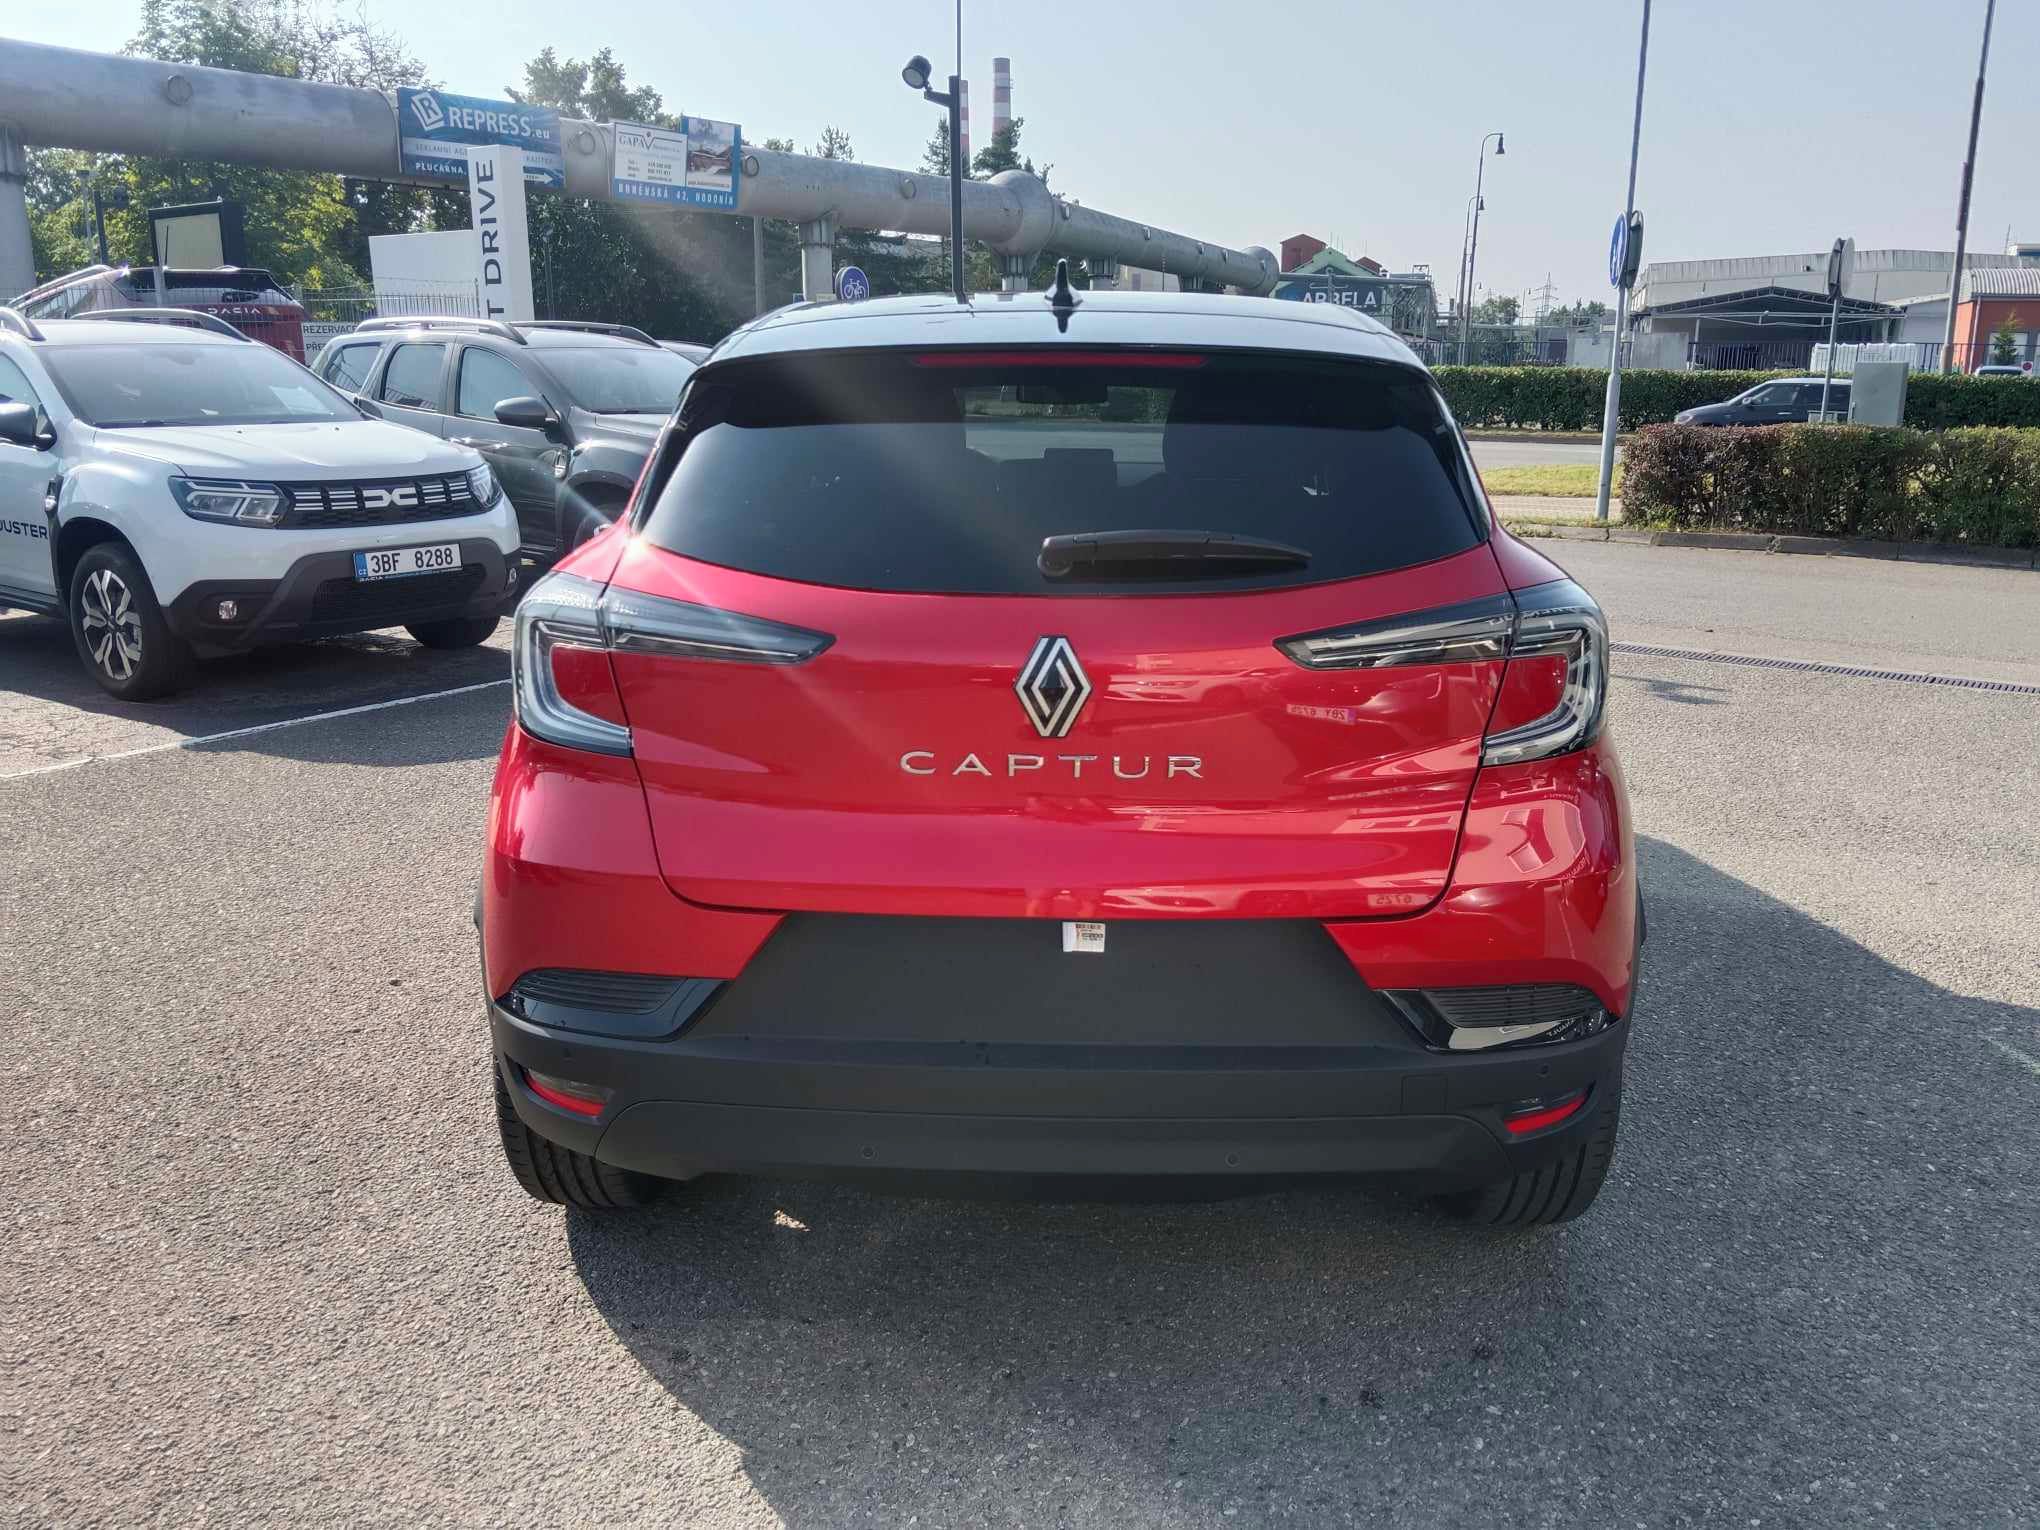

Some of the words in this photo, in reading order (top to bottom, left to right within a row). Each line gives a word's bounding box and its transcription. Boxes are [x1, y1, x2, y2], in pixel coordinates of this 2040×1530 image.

[475, 159, 503, 287] DRIVE
[0, 519, 49, 540] USTER
[370, 553, 400, 574] 3BF
[414, 547, 453, 569] 8288
[899, 750, 1204, 779] CAPTUR
